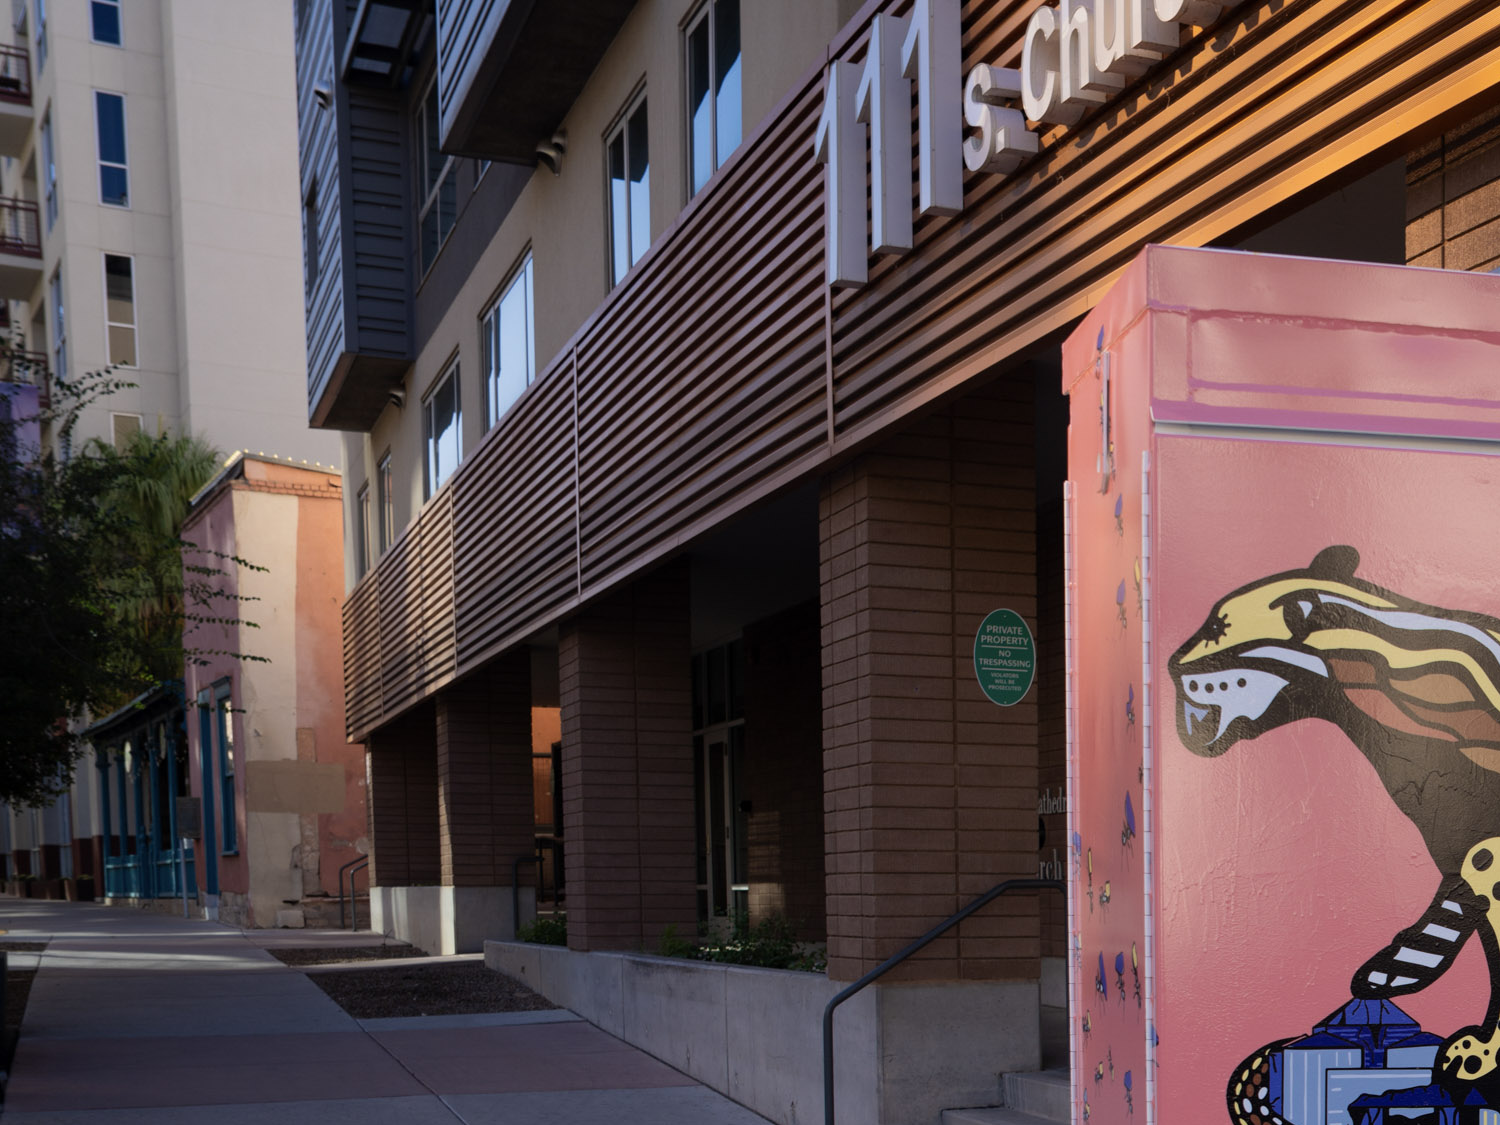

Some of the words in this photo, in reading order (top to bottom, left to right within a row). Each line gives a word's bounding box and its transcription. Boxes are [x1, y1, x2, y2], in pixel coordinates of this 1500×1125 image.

[815, 0, 962, 288] 111
[986, 625, 1023, 635] PRIVATE
[980, 634, 1028, 646] PROPERTY
[998, 649, 1011, 658] NO
[979, 657, 1031, 668] TRESPASSING
[990, 671, 1019, 679] VIOLATORS
[987, 684, 1022, 692] PROSECUTED
